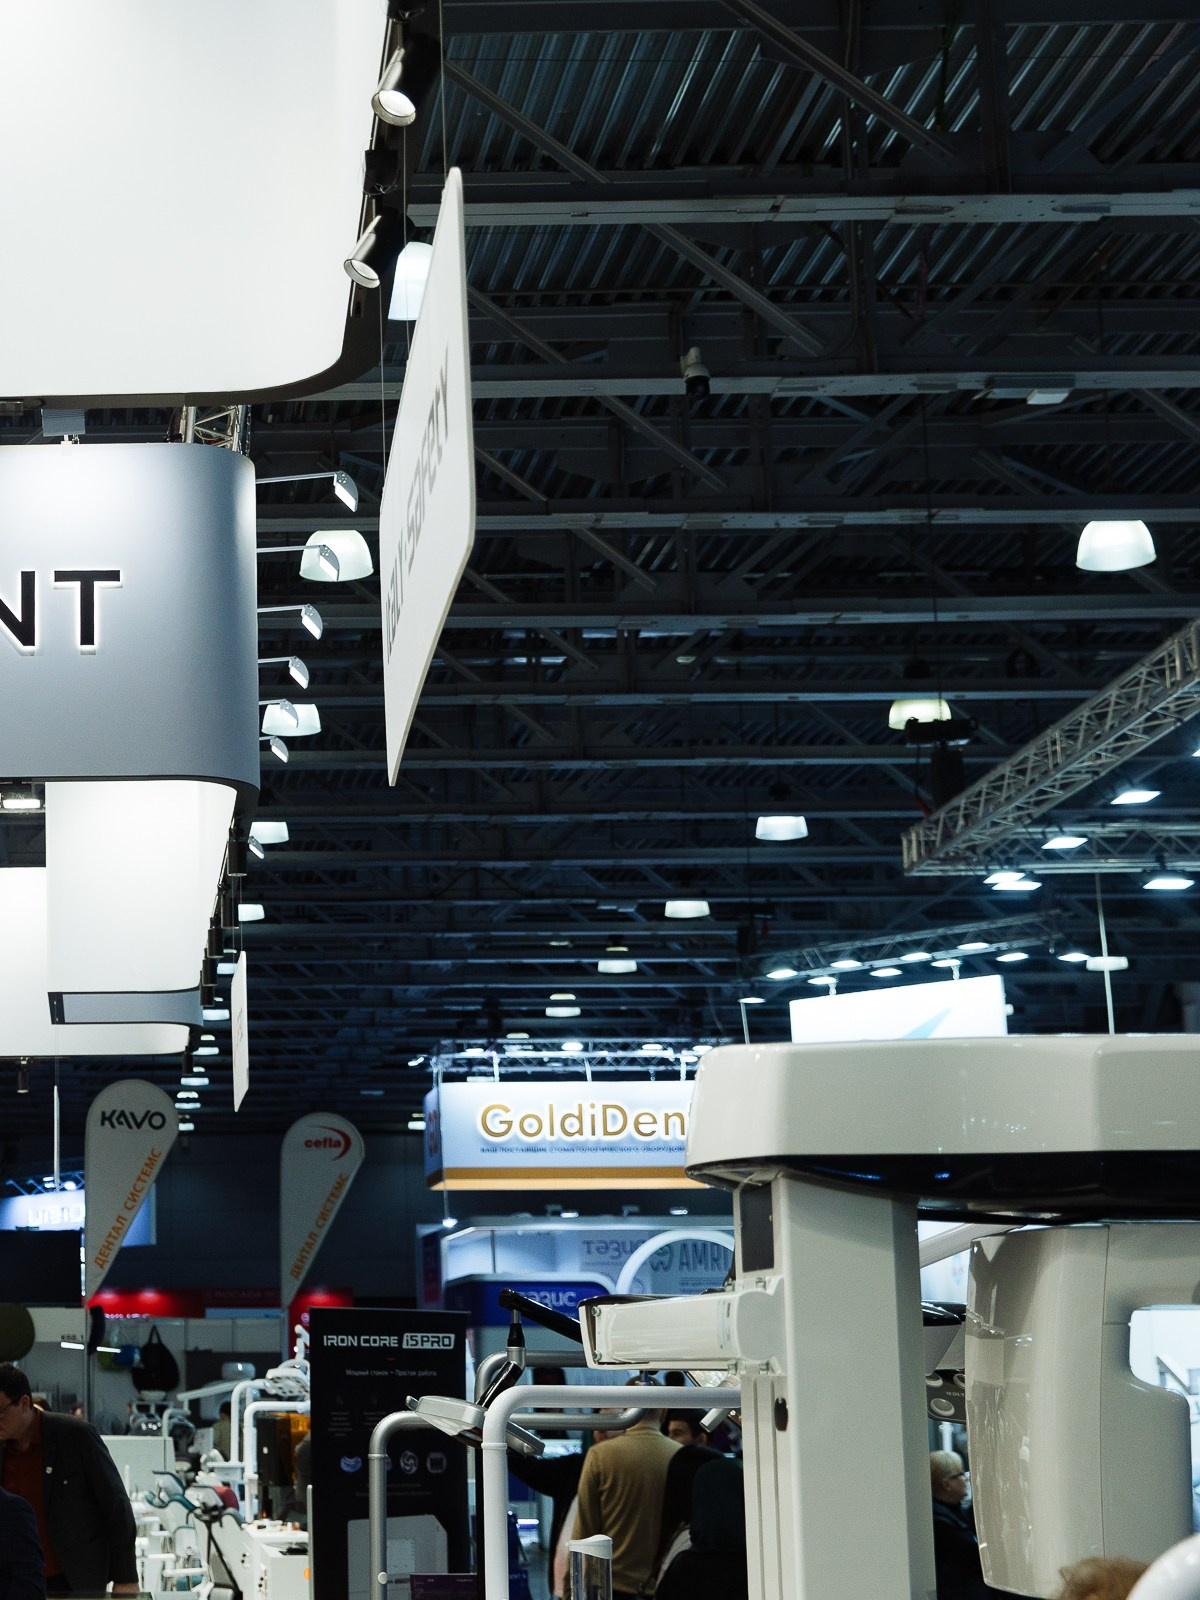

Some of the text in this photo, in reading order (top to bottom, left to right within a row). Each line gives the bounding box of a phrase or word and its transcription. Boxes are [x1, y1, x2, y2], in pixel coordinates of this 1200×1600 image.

[481, 1103, 690, 1138] GoldiDen
[94, 1214, 128, 1271] ДЕНТАЛ
[123, 1148, 162, 1212] СИСТЕМС
[323, 1334, 357, 1347] IRON
[360, 1335, 399, 1347] CORE
